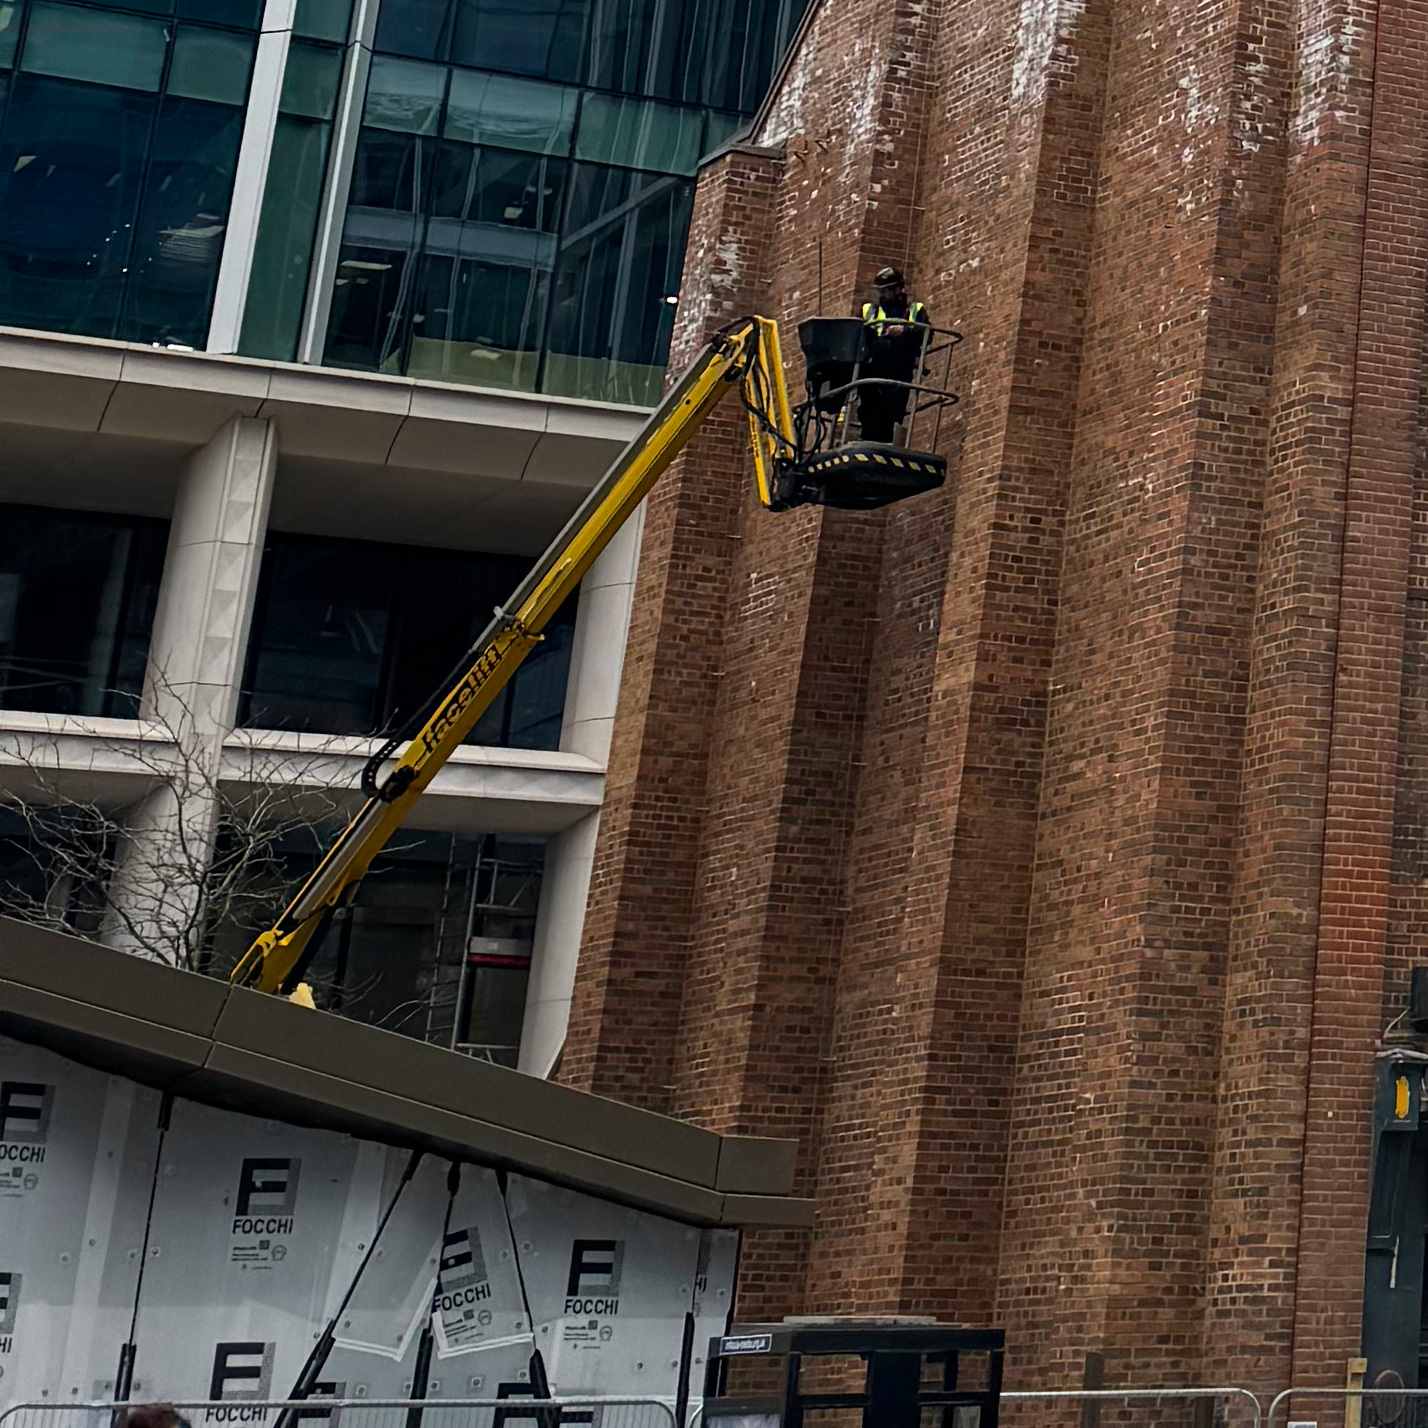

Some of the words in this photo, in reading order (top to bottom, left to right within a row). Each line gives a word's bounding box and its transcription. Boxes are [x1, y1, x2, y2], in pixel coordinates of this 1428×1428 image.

[422, 644, 502, 753] facelift
[0, 1144, 46, 1163] OCCHI
[232, 1218, 294, 1235] FOCCHI
[433, 1282, 492, 1311] FOCCHI
[564, 1298, 619, 1316] FOCCHI
[205, 1406, 267, 1422] FOCCHI
